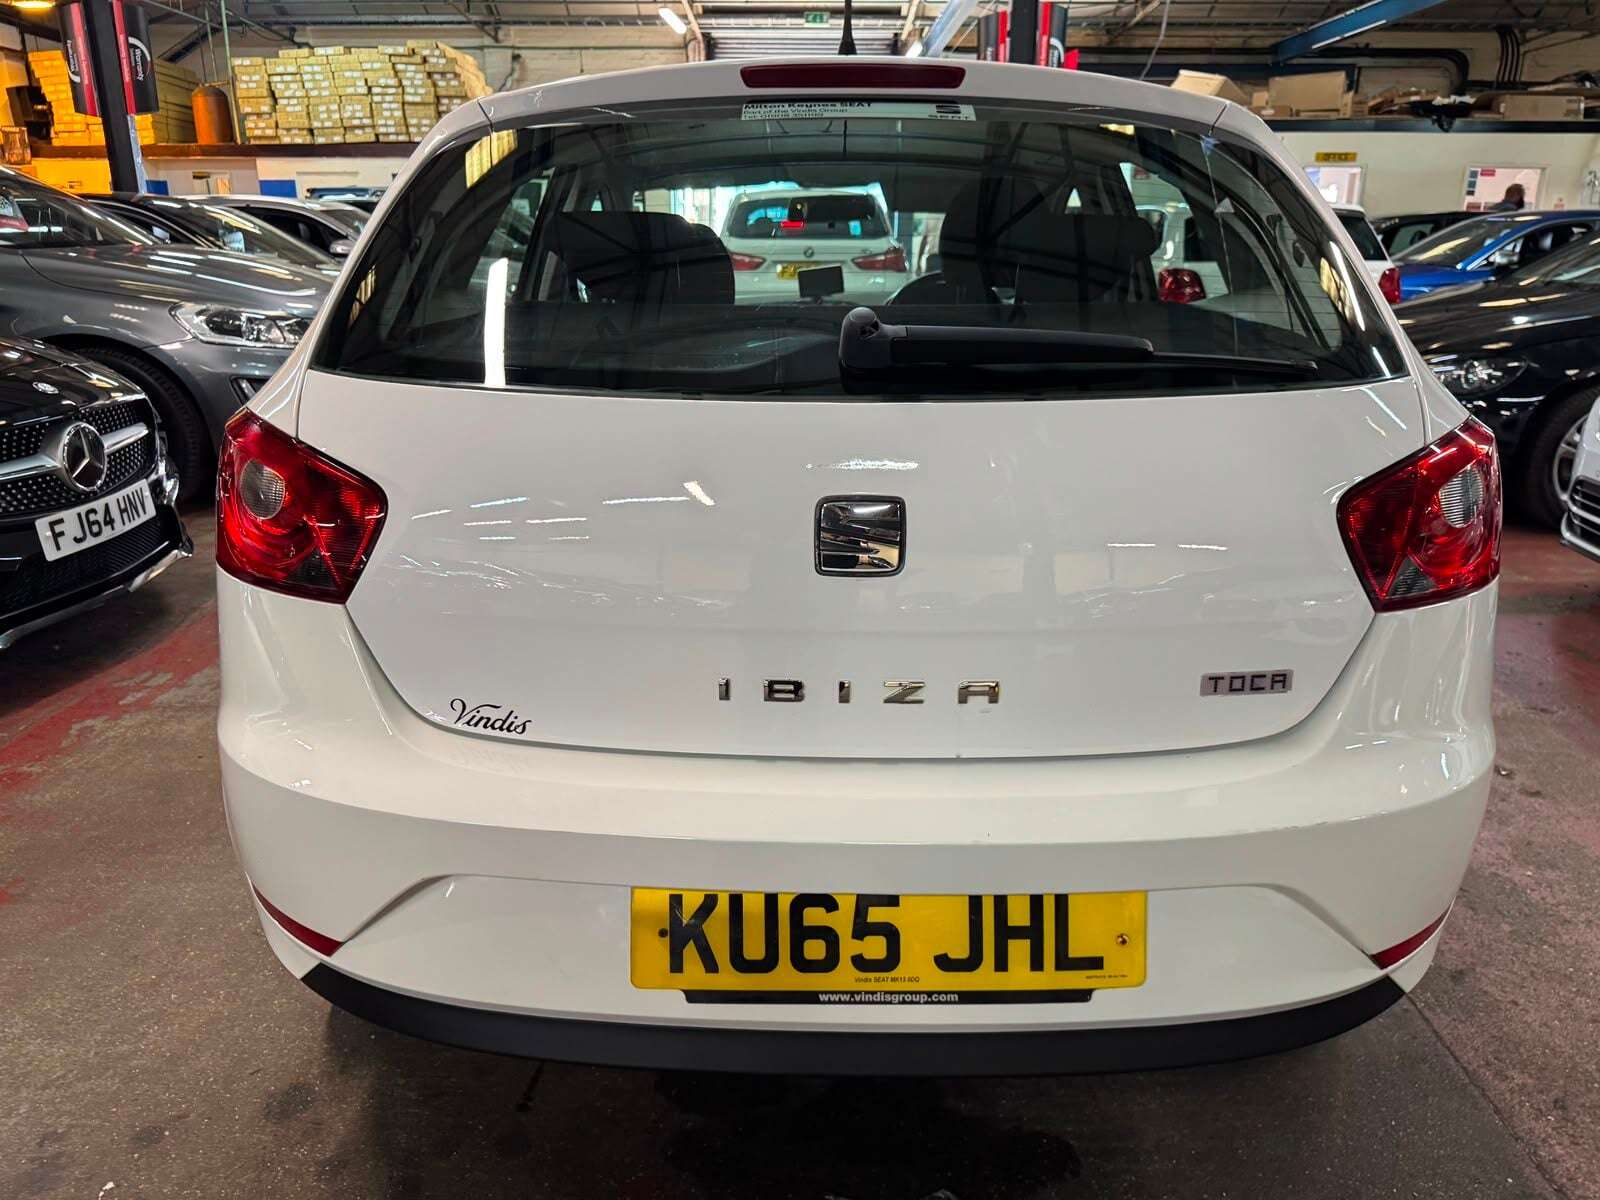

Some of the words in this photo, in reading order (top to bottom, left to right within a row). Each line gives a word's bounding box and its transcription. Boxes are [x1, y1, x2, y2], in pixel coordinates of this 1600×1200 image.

[48, 503, 115, 551] FJ64
[116, 487, 147, 526] HNV
[718, 677, 1000, 704] IBIZA
[1208, 673, 1287, 693] TOCA
[450, 698, 532, 734] Vindis
[668, 894, 901, 974] KU65
[934, 894, 1104, 973] JHL
[873, 975, 889, 983] SEAT
[818, 992, 959, 1003] www.vindisgroup.com
